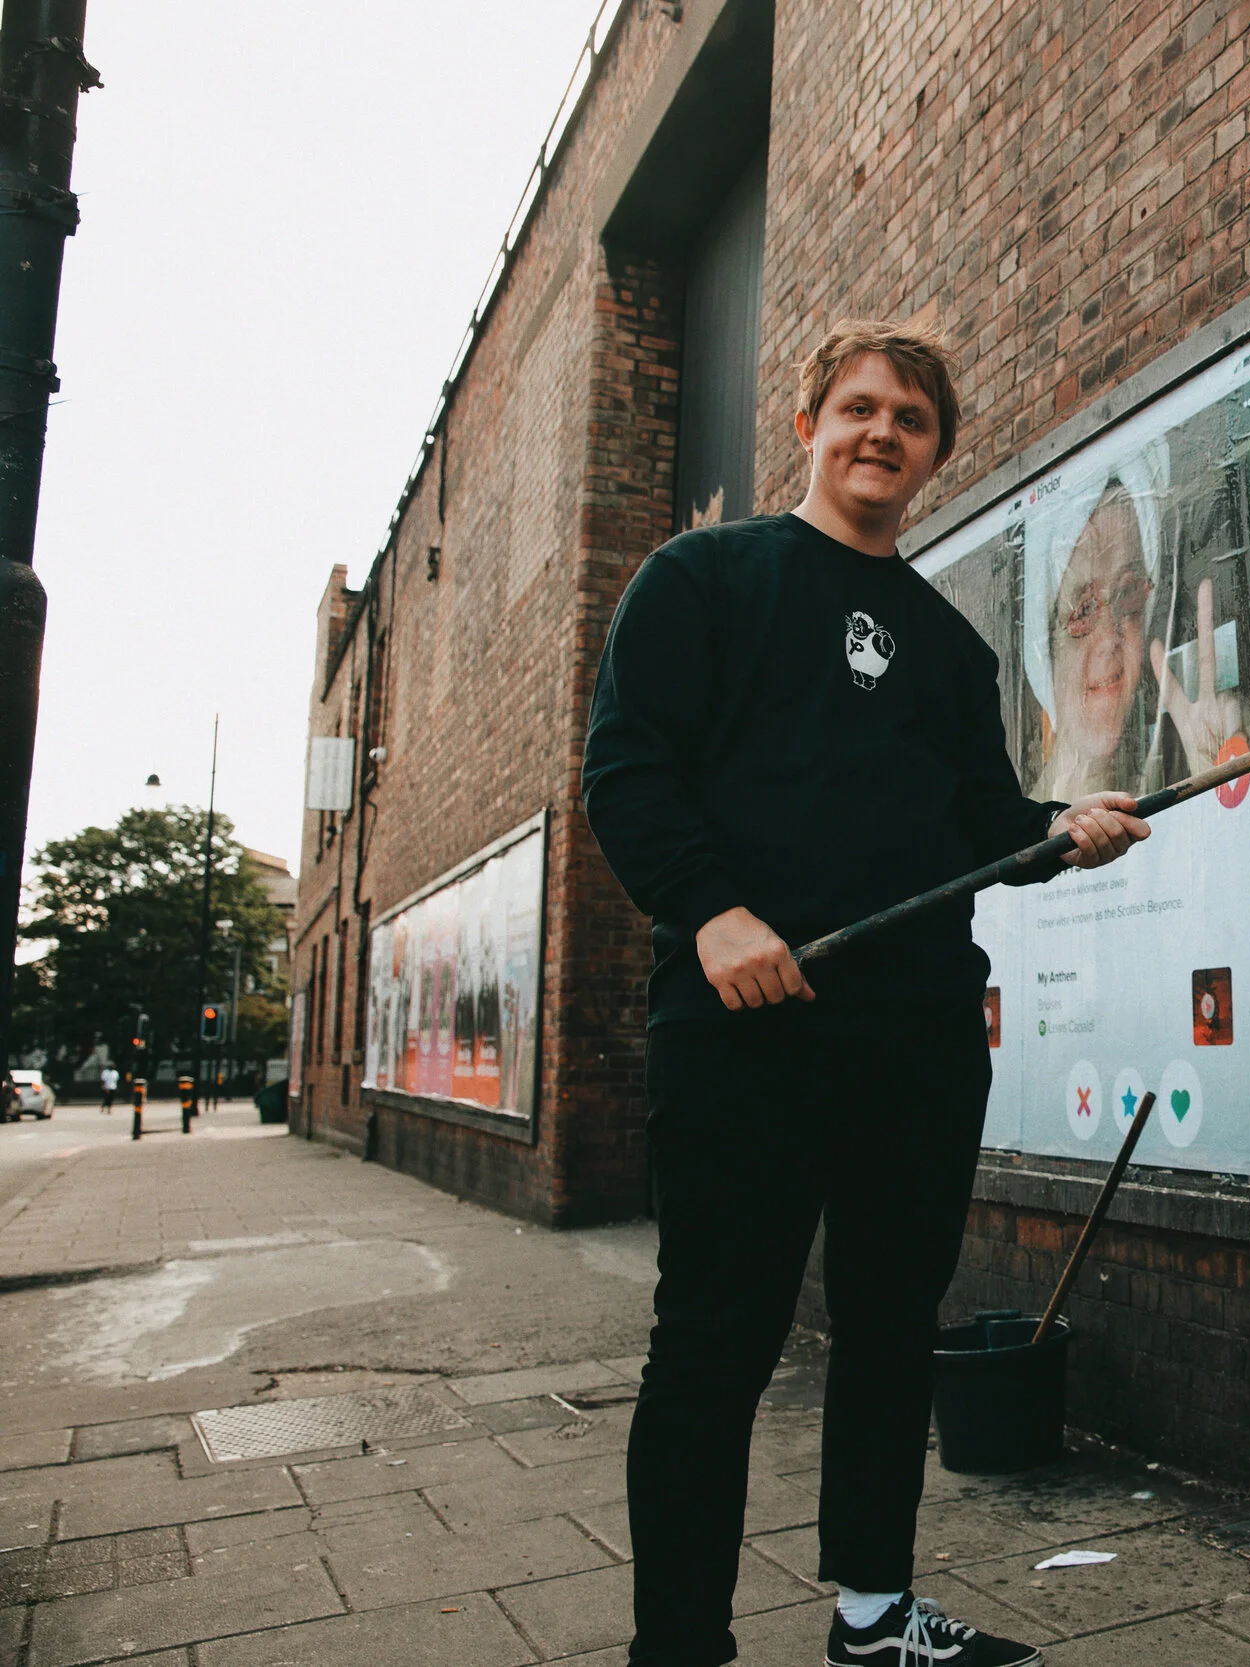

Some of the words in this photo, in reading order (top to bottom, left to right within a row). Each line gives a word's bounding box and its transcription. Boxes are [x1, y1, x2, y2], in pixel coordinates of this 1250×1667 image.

[1037, 475, 1062, 500] tinder
[1095, 910, 1103, 921] as
[1104, 908, 1117, 920] the
[1117, 902, 1146, 918] Scottish
[1038, 972, 1048, 987] My
[1050, 970, 1077, 983] Anthem
